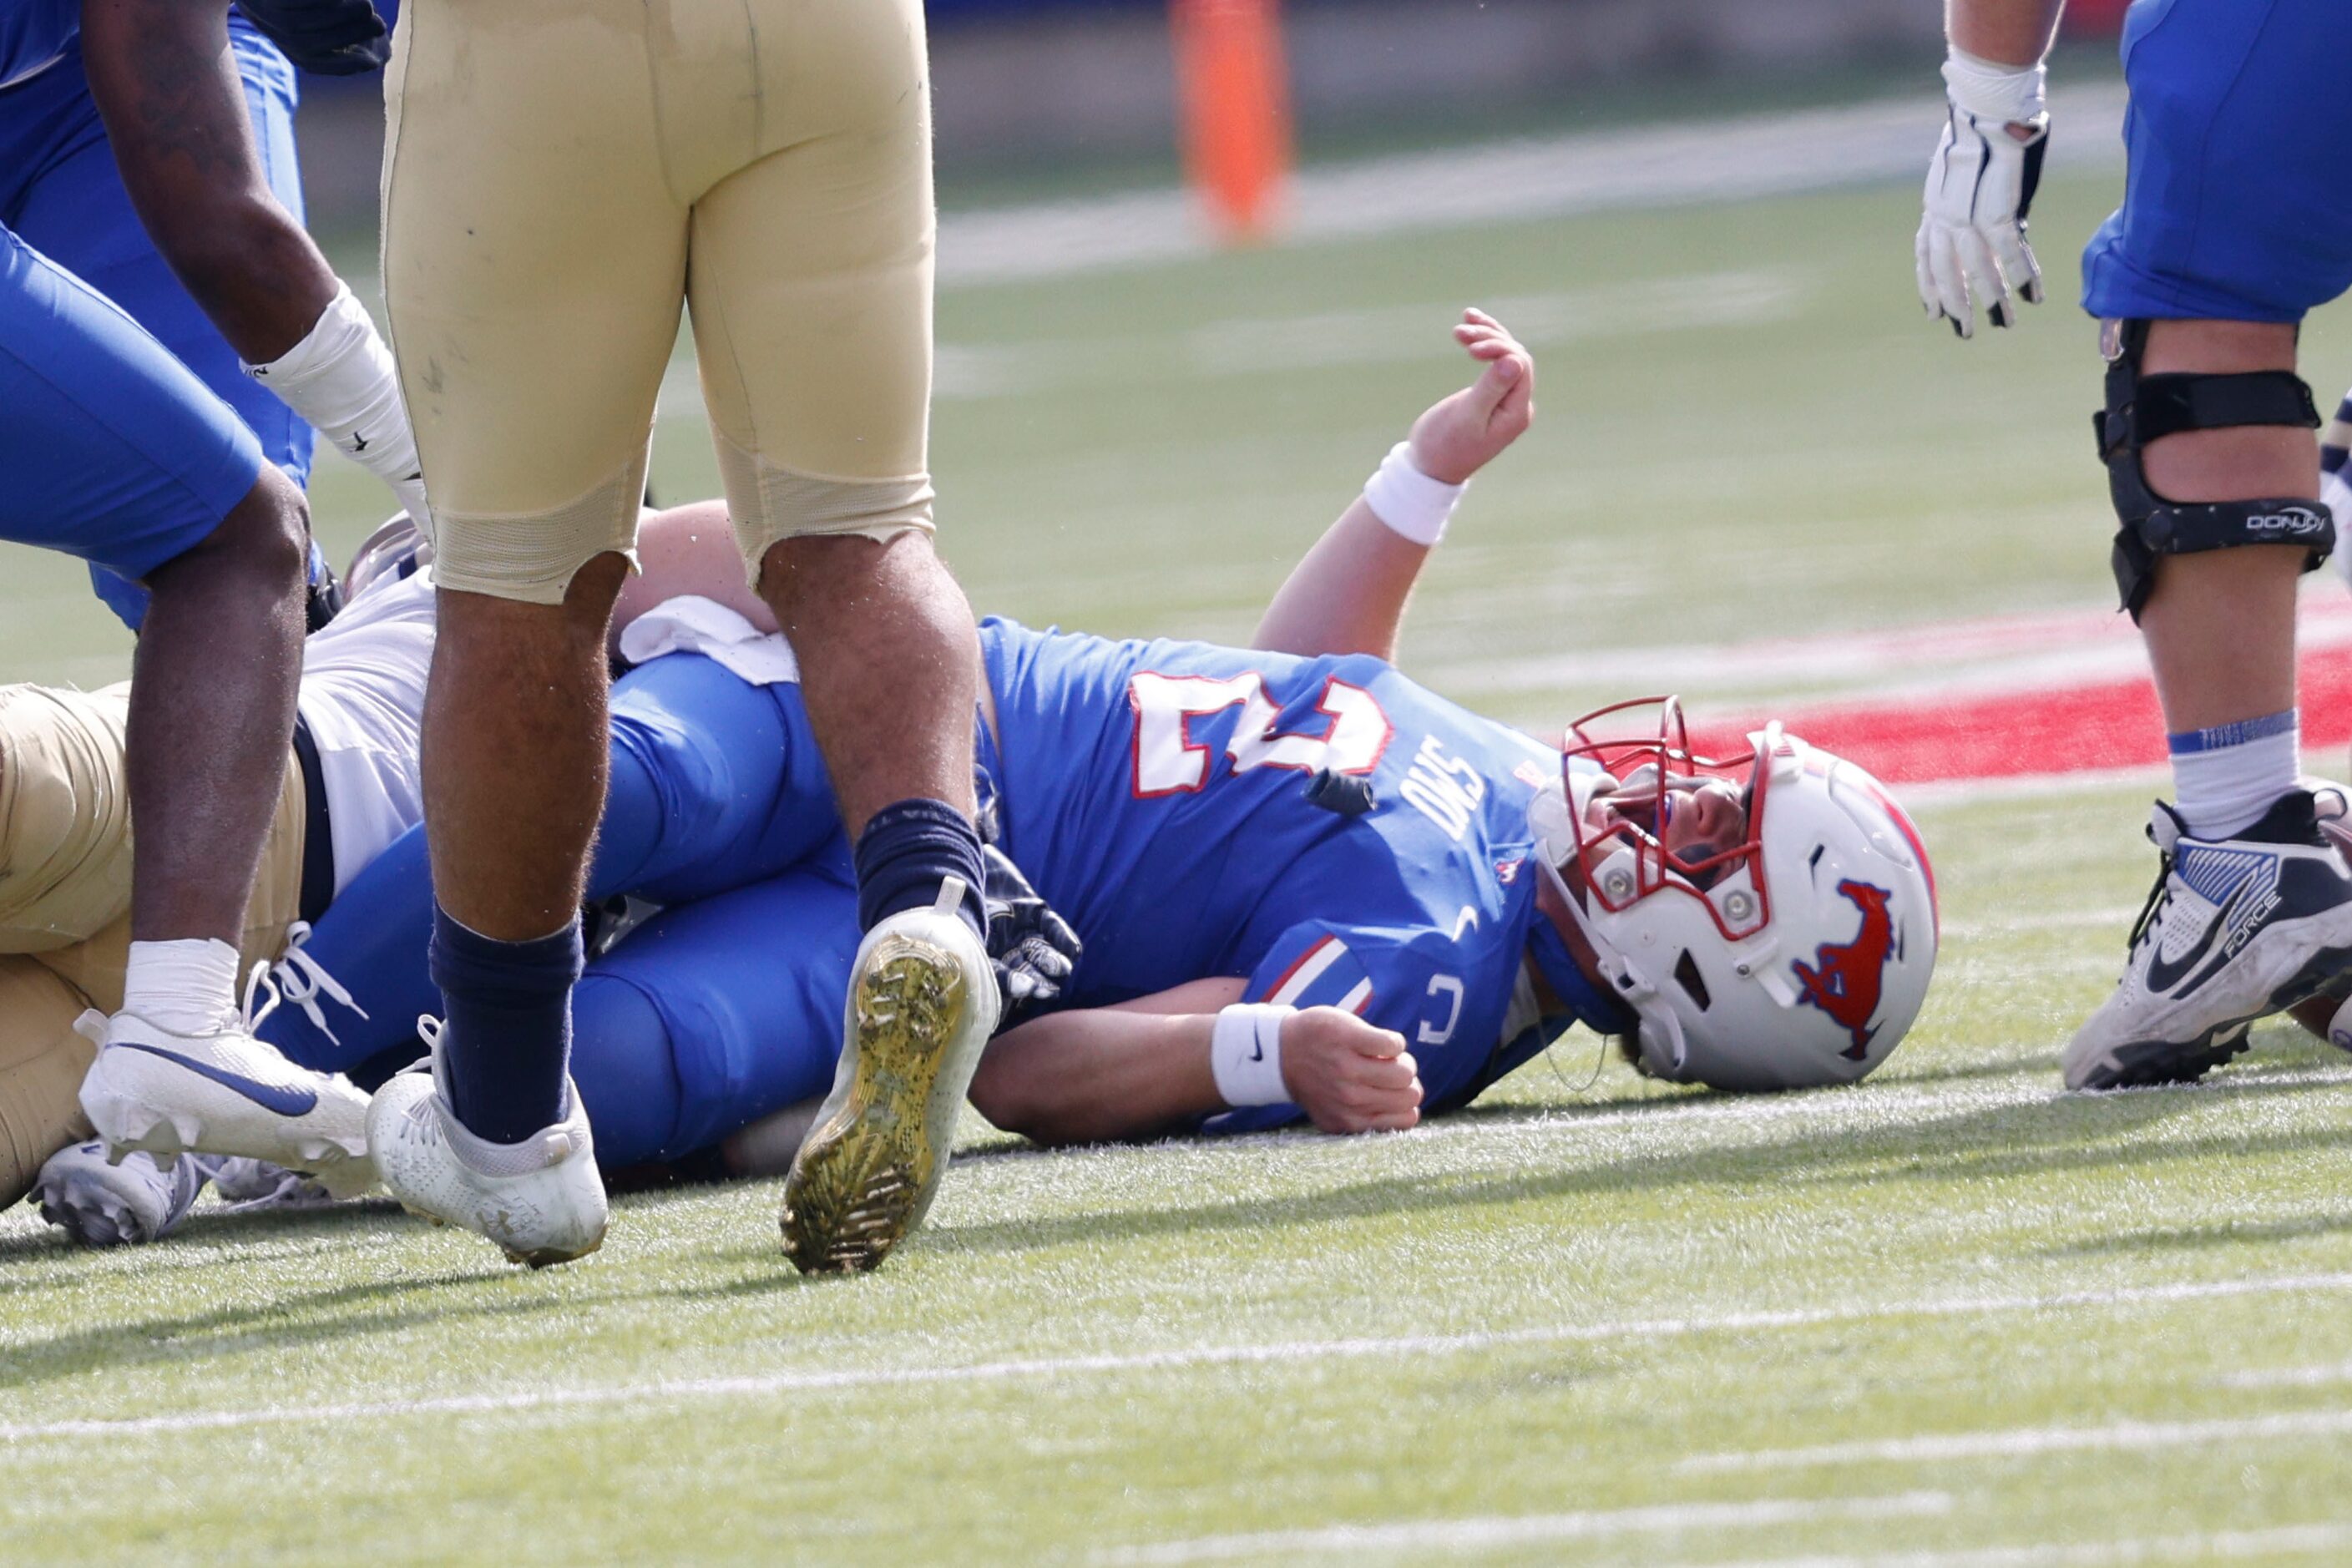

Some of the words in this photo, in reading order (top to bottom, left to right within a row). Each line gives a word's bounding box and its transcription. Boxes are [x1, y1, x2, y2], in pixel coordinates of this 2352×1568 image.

[2246, 515, 2325, 532] DONJOY
[1129, 670, 1395, 799] 2
[2224, 890, 2282, 959] FORCE
